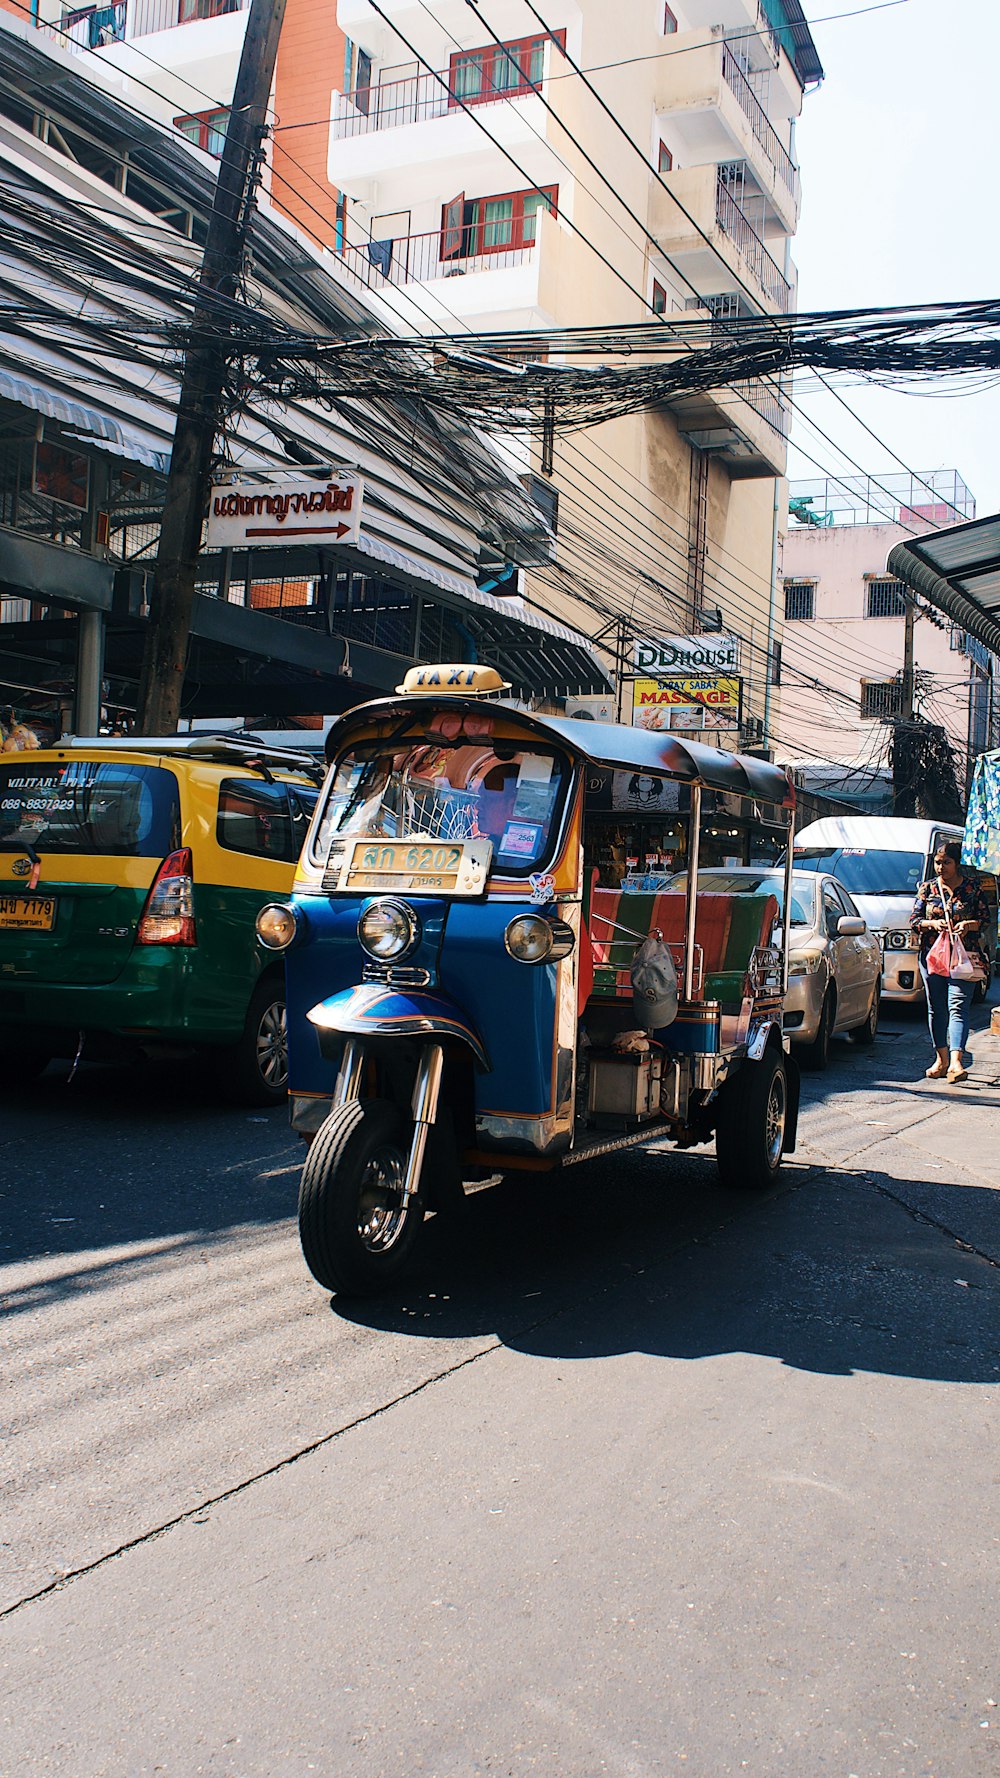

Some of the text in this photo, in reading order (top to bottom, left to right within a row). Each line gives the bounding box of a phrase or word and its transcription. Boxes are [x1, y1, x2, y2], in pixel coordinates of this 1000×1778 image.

[417, 668, 477, 685] TAXI
[657, 680, 719, 691] SABAY SABAY
[640, 691, 731, 704] MASSAGE
[589, 776, 607, 790] DY
[518, 834, 535, 842] 2563
[361, 846, 462, 870] สก 6202
[23, 900, 51, 915] 7179
